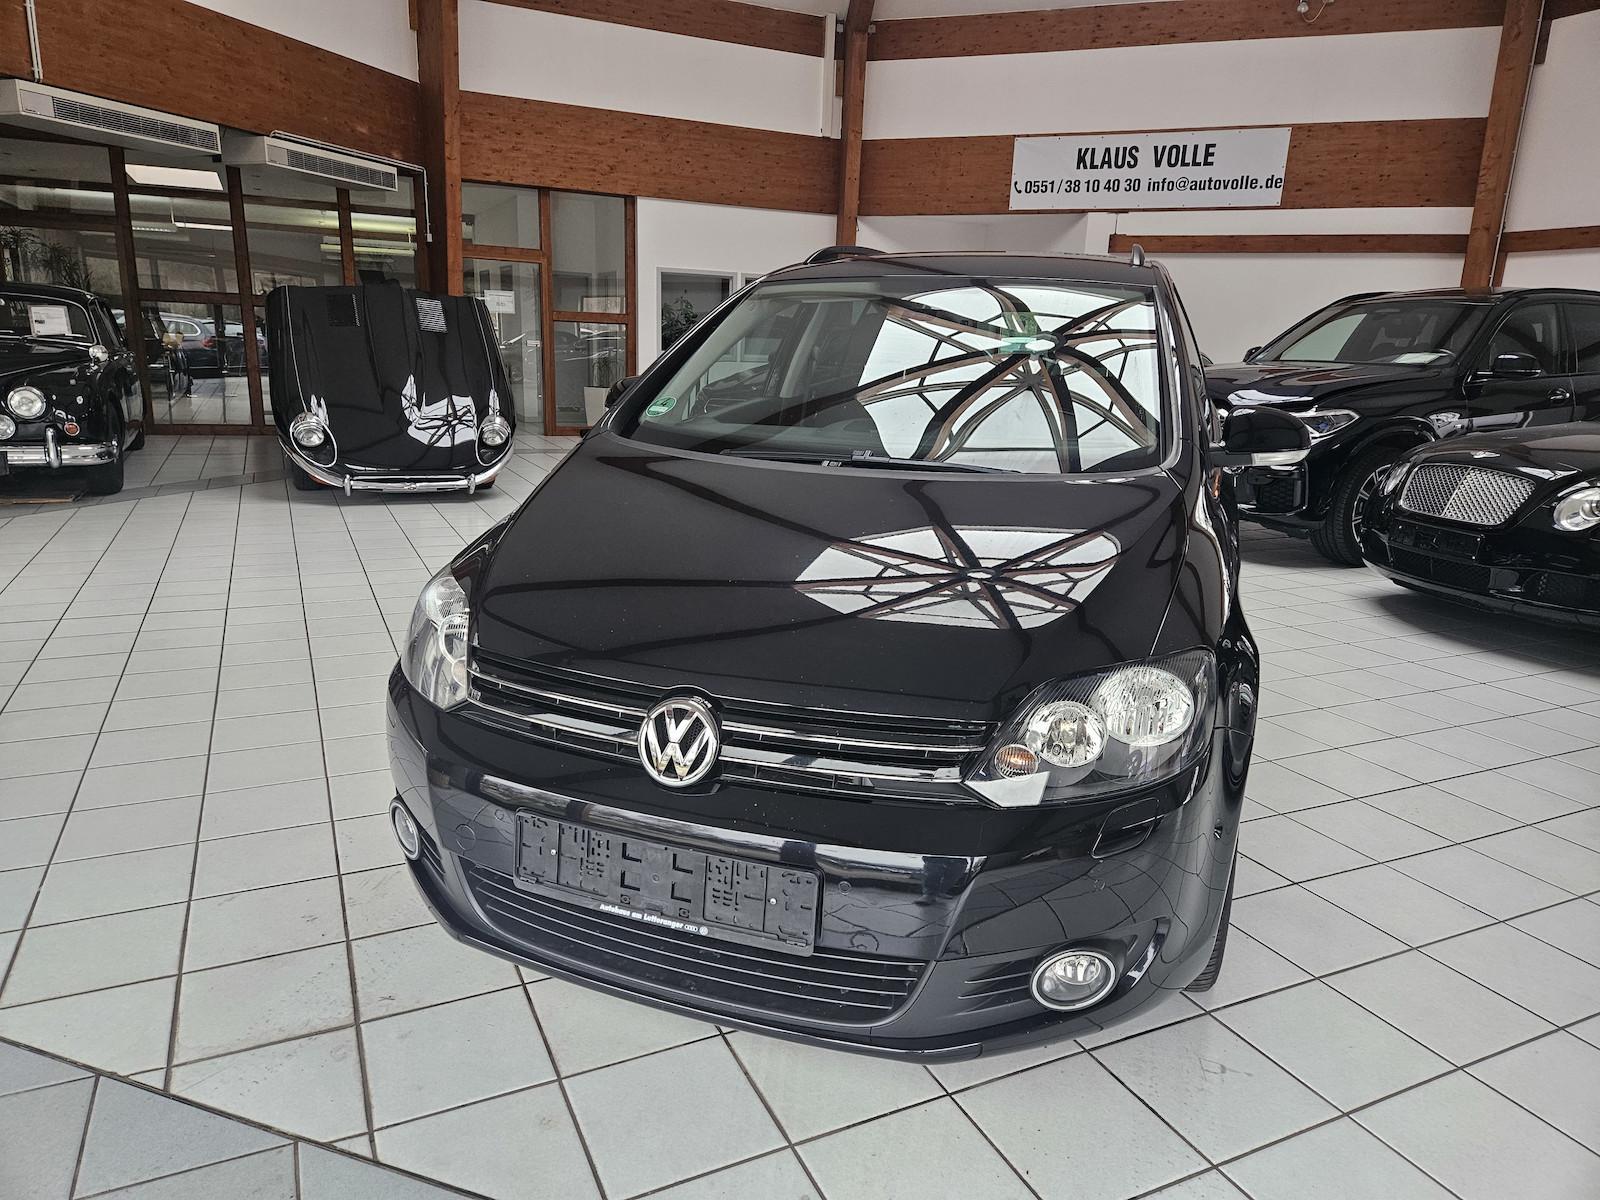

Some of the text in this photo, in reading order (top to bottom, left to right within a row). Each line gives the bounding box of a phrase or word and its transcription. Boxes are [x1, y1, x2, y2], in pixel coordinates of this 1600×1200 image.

[1076, 143, 1217, 170] KLAUS VOLLE
[1084, 179, 1100, 193] 10
[1103, 178, 1120, 192] 40
[1124, 178, 1141, 192] 30
[1147, 174, 1283, 192] info@autovolle.de
